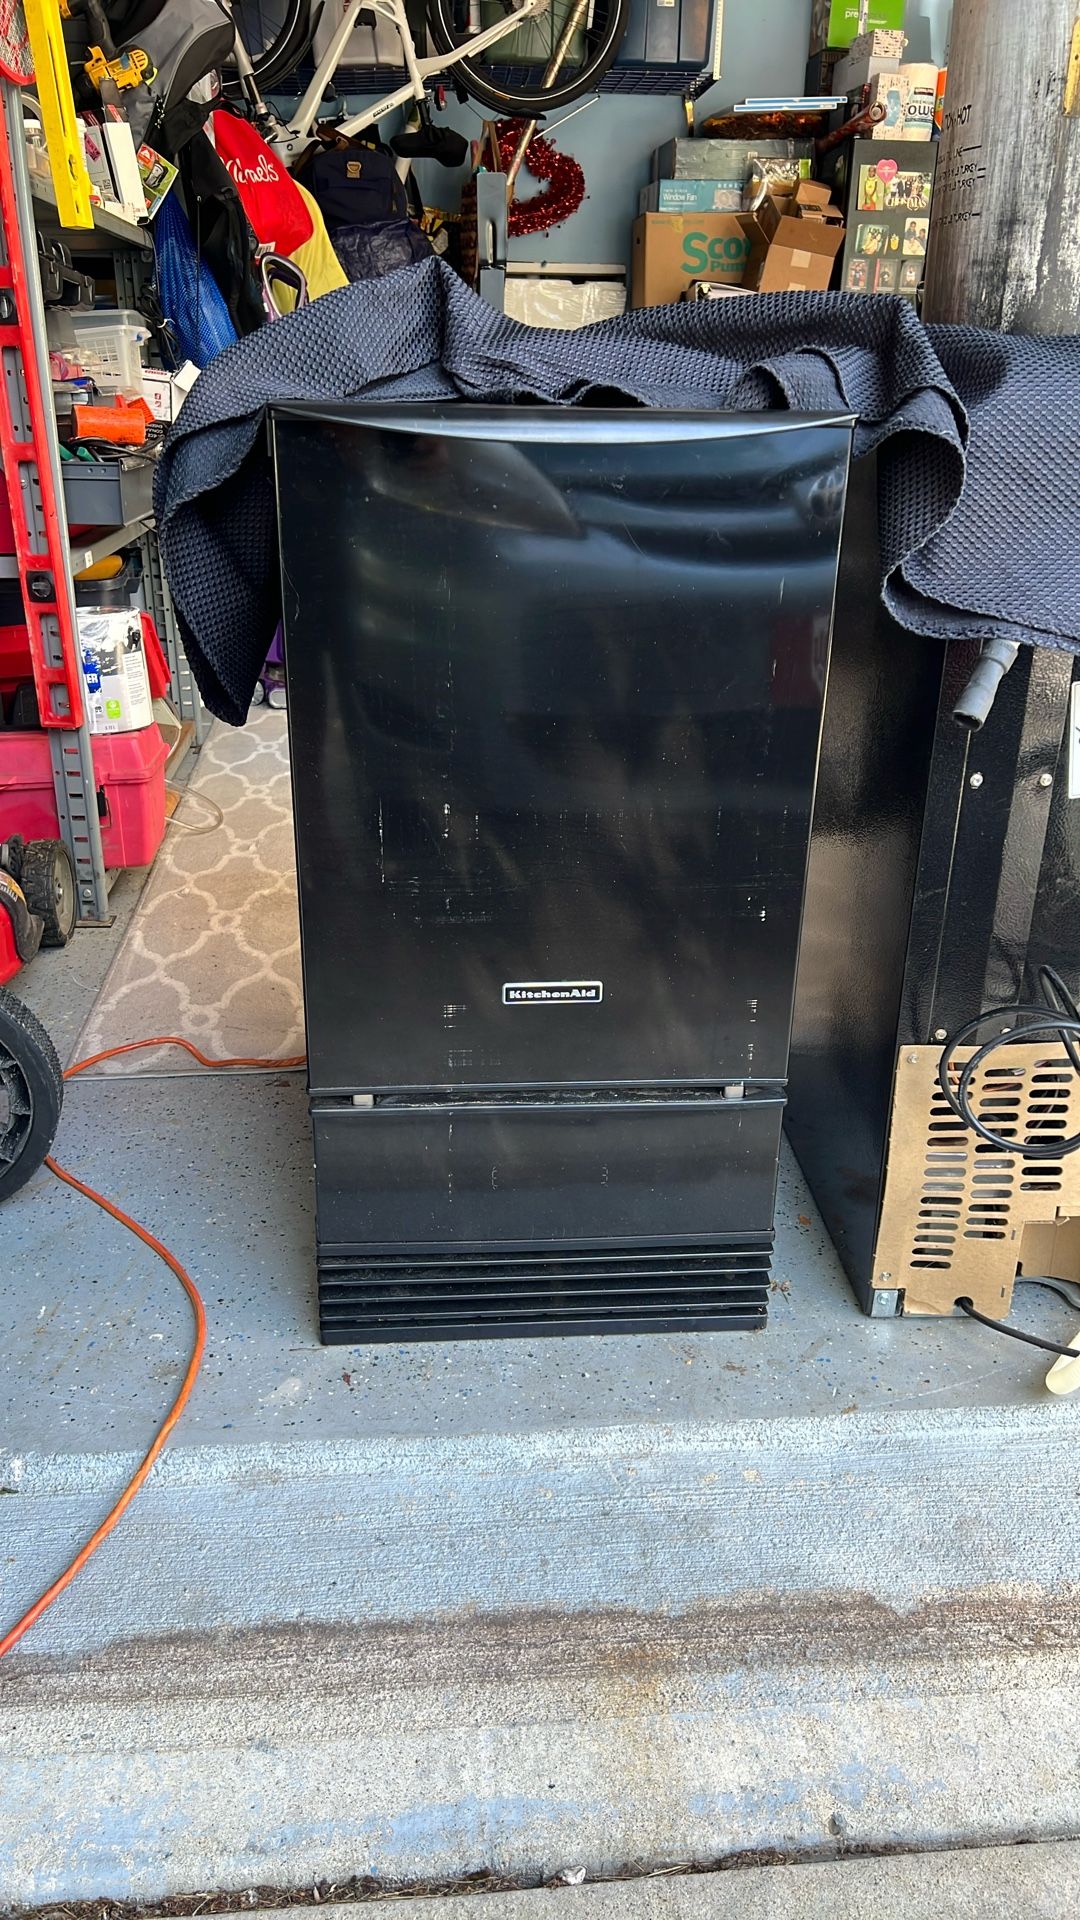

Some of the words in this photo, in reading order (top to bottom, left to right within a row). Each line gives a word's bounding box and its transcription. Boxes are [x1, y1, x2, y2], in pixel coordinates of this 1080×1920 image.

[844, 10, 859, 20] pre
[908, 104, 934, 118] owe
[663, 193, 685, 201] Window
[686, 193, 698, 201] Fan
[86, 673, 98, 684] ER
[509, 989, 596, 999] KitchenAid
